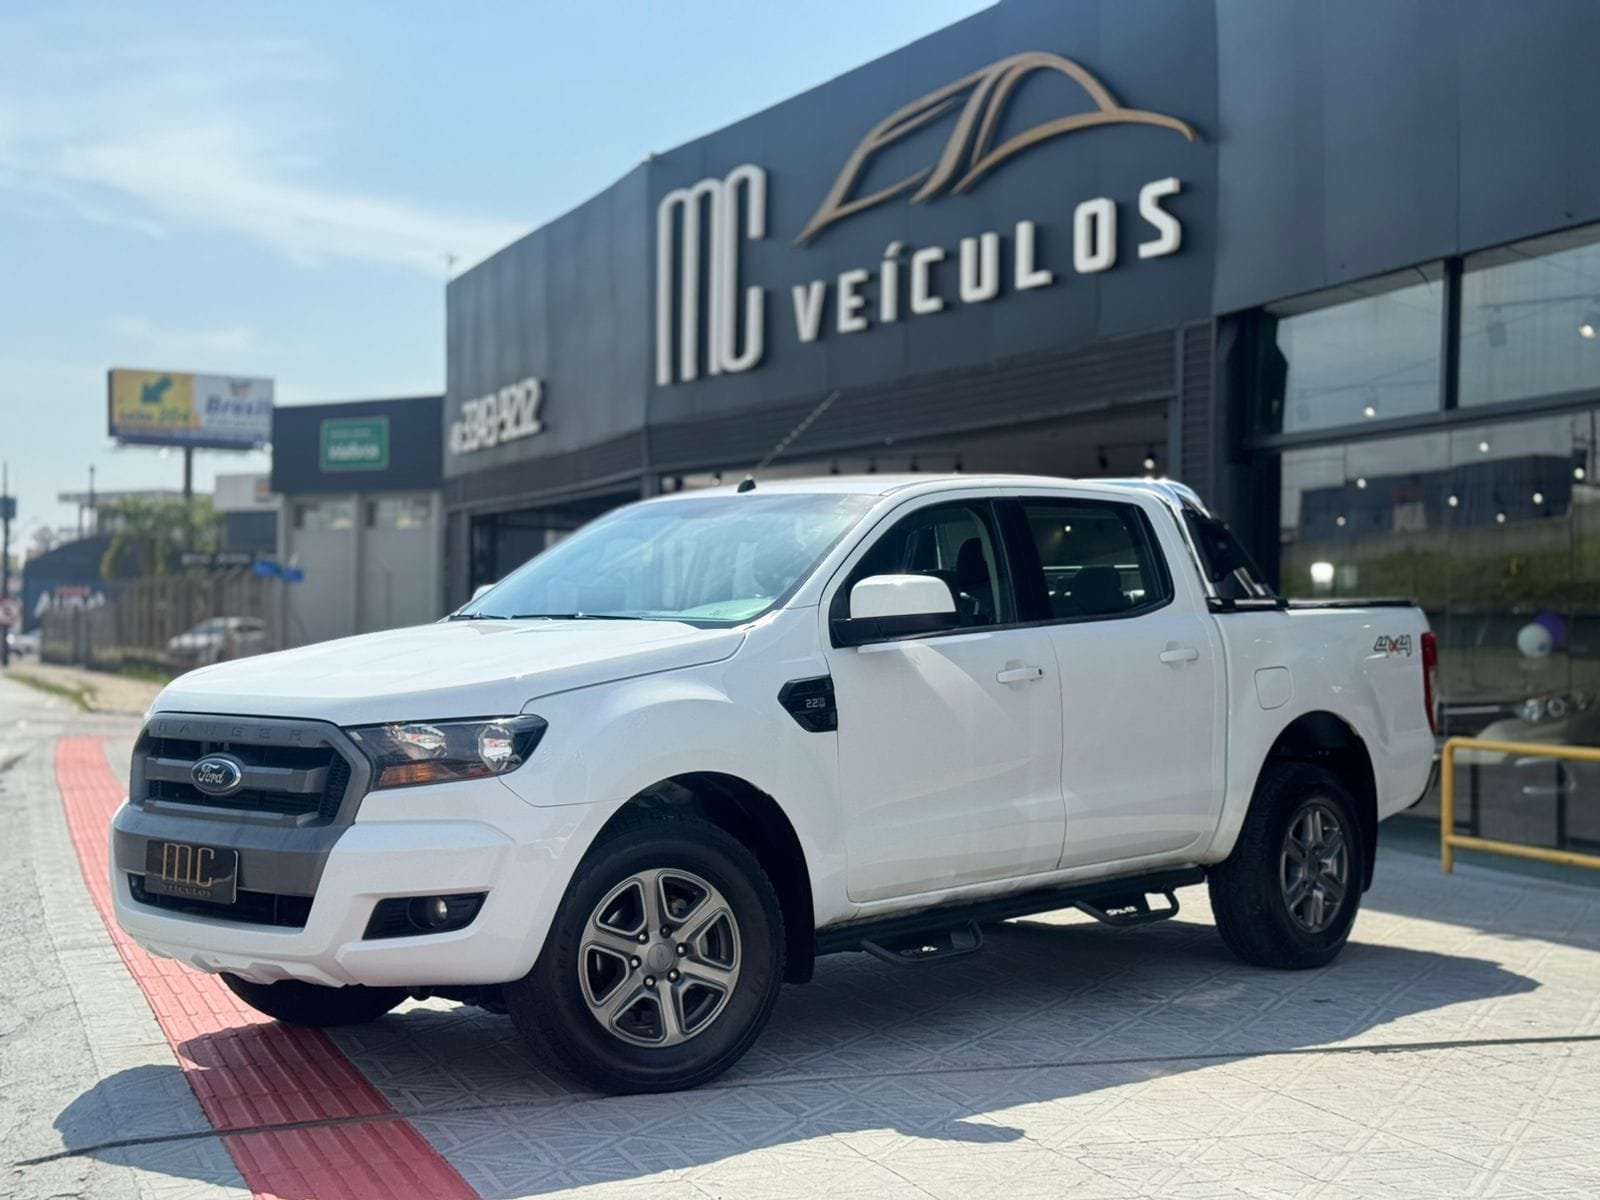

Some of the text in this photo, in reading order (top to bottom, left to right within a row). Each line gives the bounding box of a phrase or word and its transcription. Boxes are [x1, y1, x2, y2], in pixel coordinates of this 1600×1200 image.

[656, 164, 1182, 386] MC VEÍCULOS
[157, 721, 302, 742] RANGER
[198, 762, 225, 785] Ford
[162, 842, 214, 887] MC
